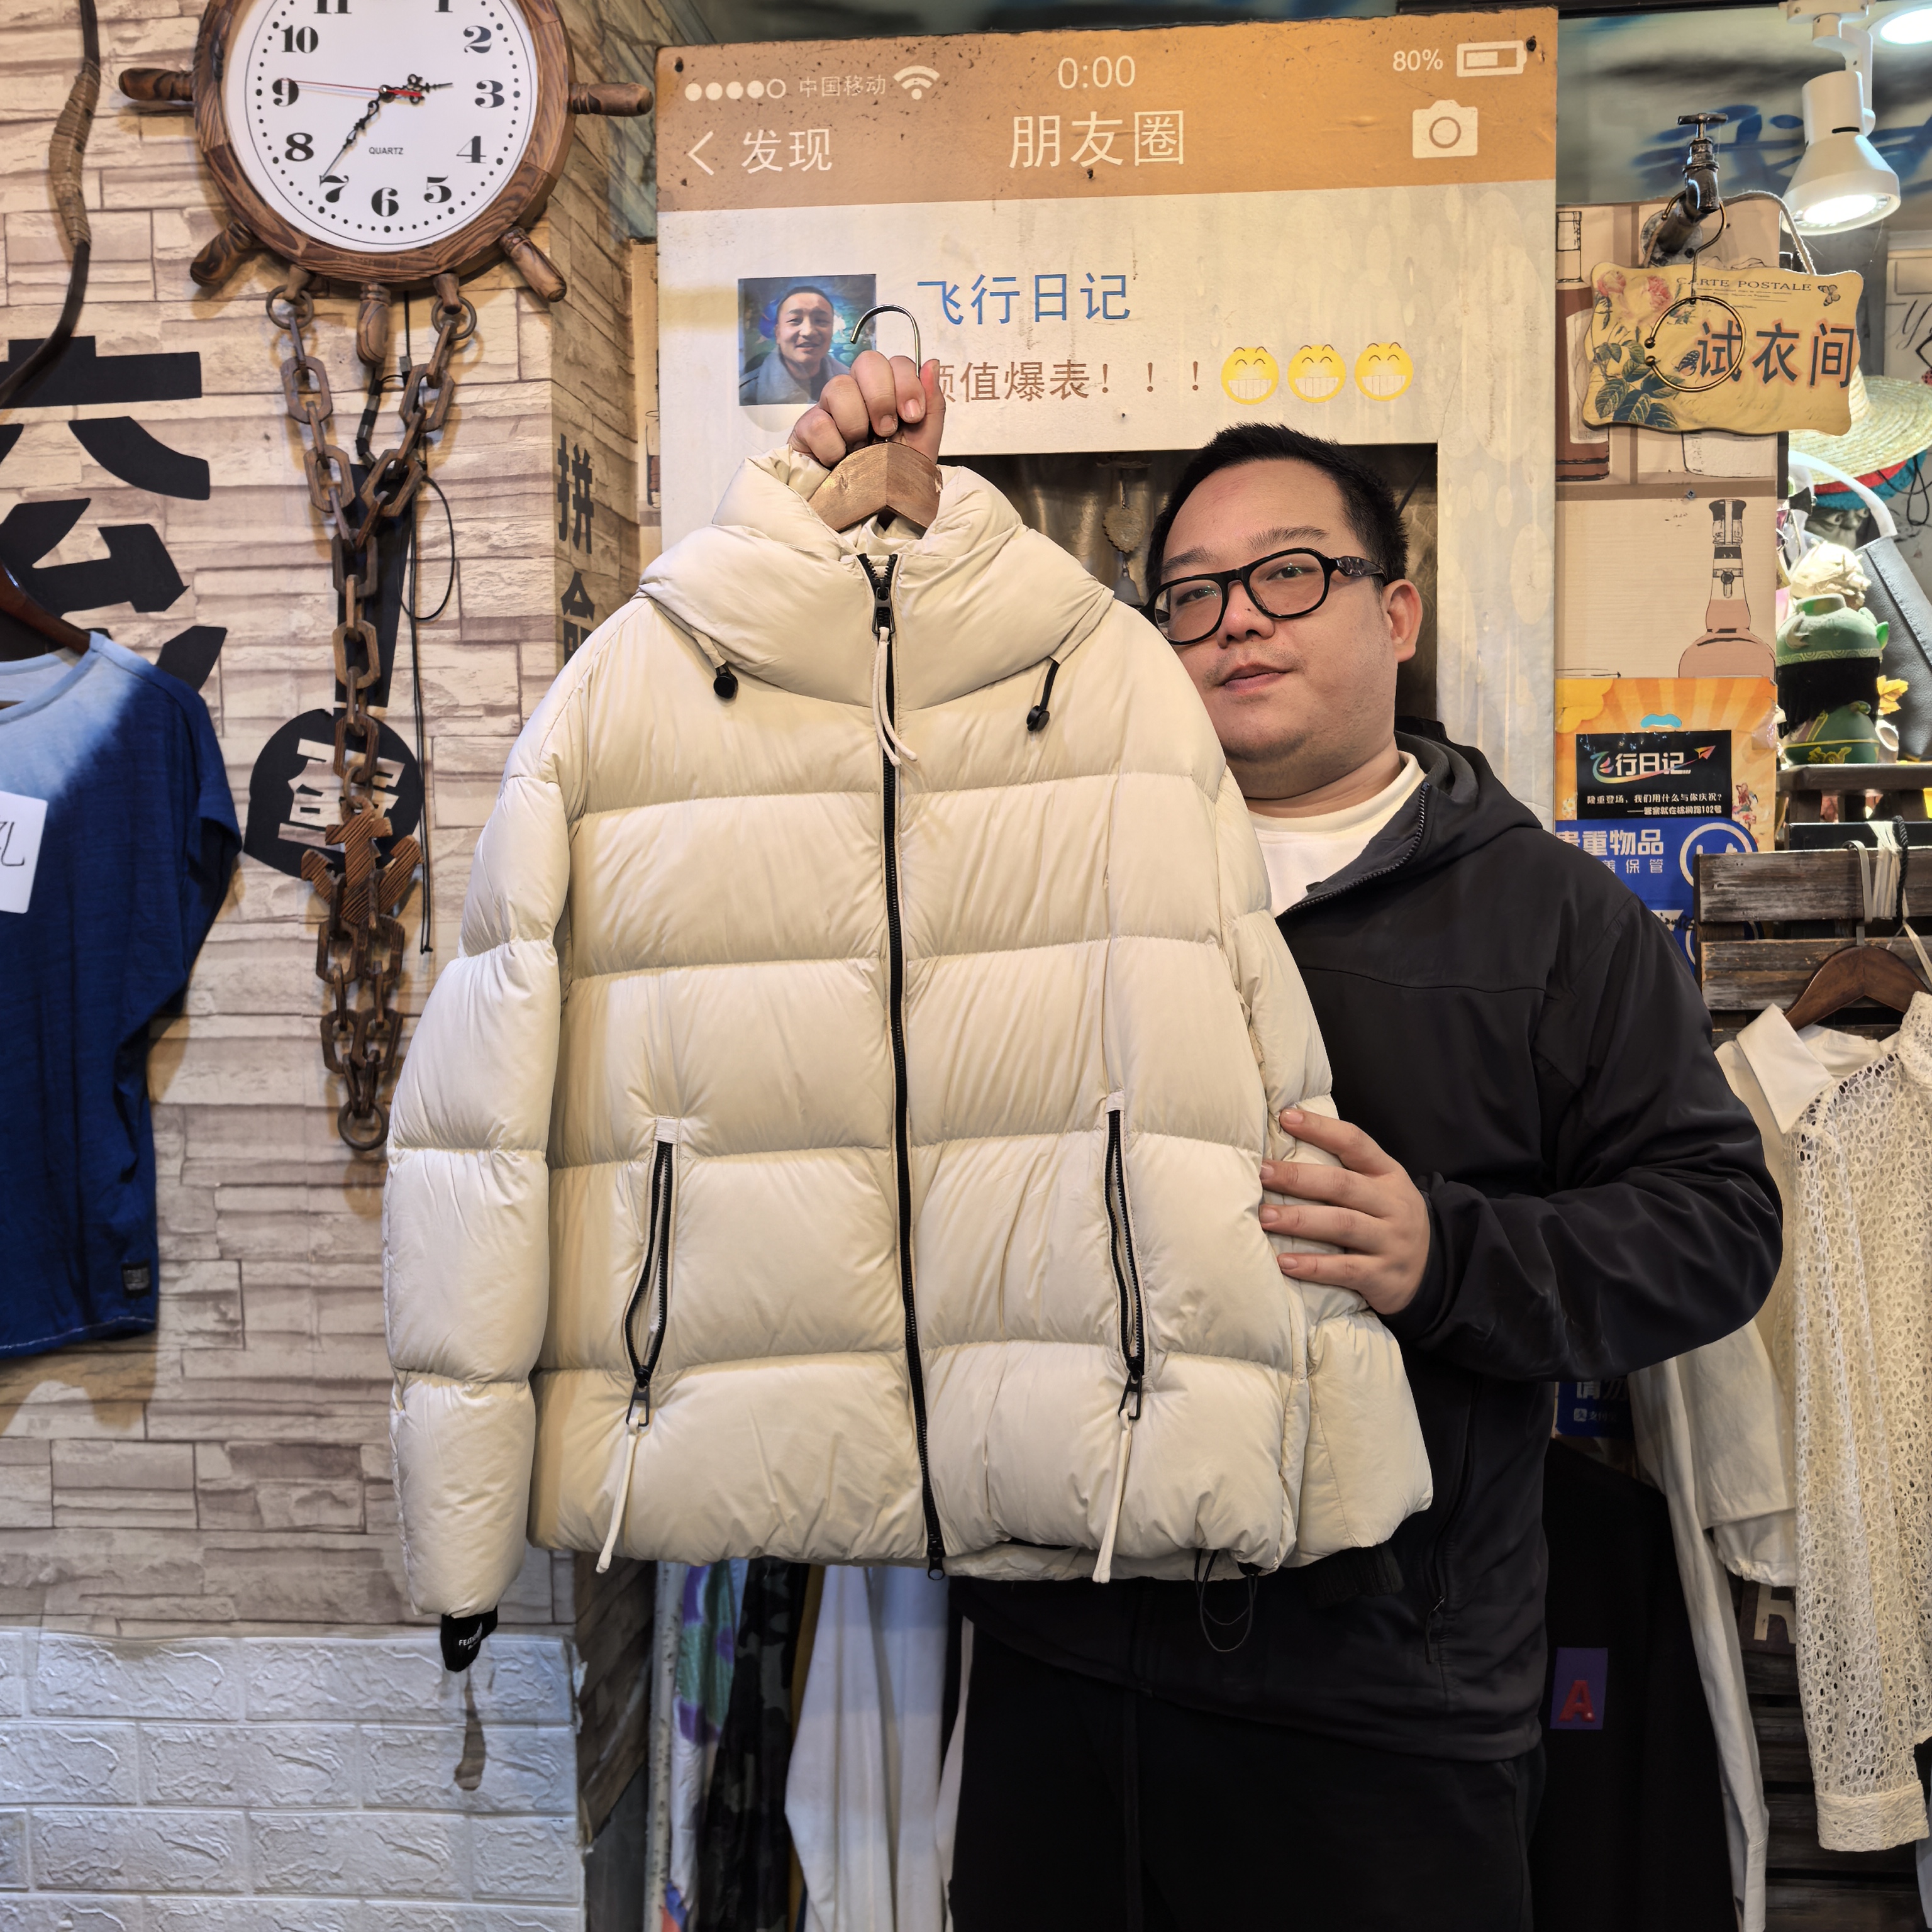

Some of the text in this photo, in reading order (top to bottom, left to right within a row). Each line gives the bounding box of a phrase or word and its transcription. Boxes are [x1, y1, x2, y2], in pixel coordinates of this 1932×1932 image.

[280, 25, 319, 53] 10
[463, 25, 492, 53] 2
[1057, 55, 1136, 90] 0:00
[1392, 49, 1444, 72] 80%
[272, 77, 299, 107] 9
[474, 79, 505, 108] 3
[798, 74, 887, 97] 中国移动
[284, 132, 314, 162] 8
[369, 147, 404, 155] QUARTZ
[456, 135, 487, 164] 4
[740, 128, 833, 174] 发现
[1008, 109, 1185, 169] 朋友圈
[319, 174, 350, 203] 7
[371, 187, 399, 217] 6
[423, 175, 452, 203] 5
[1676, 277, 1812, 291] CRTE POSTALE
[916, 272, 1131, 326] 飞行日记
[1697, 321, 1856, 389] 试衣间
[1557, 1680, 1596, 1722] A
